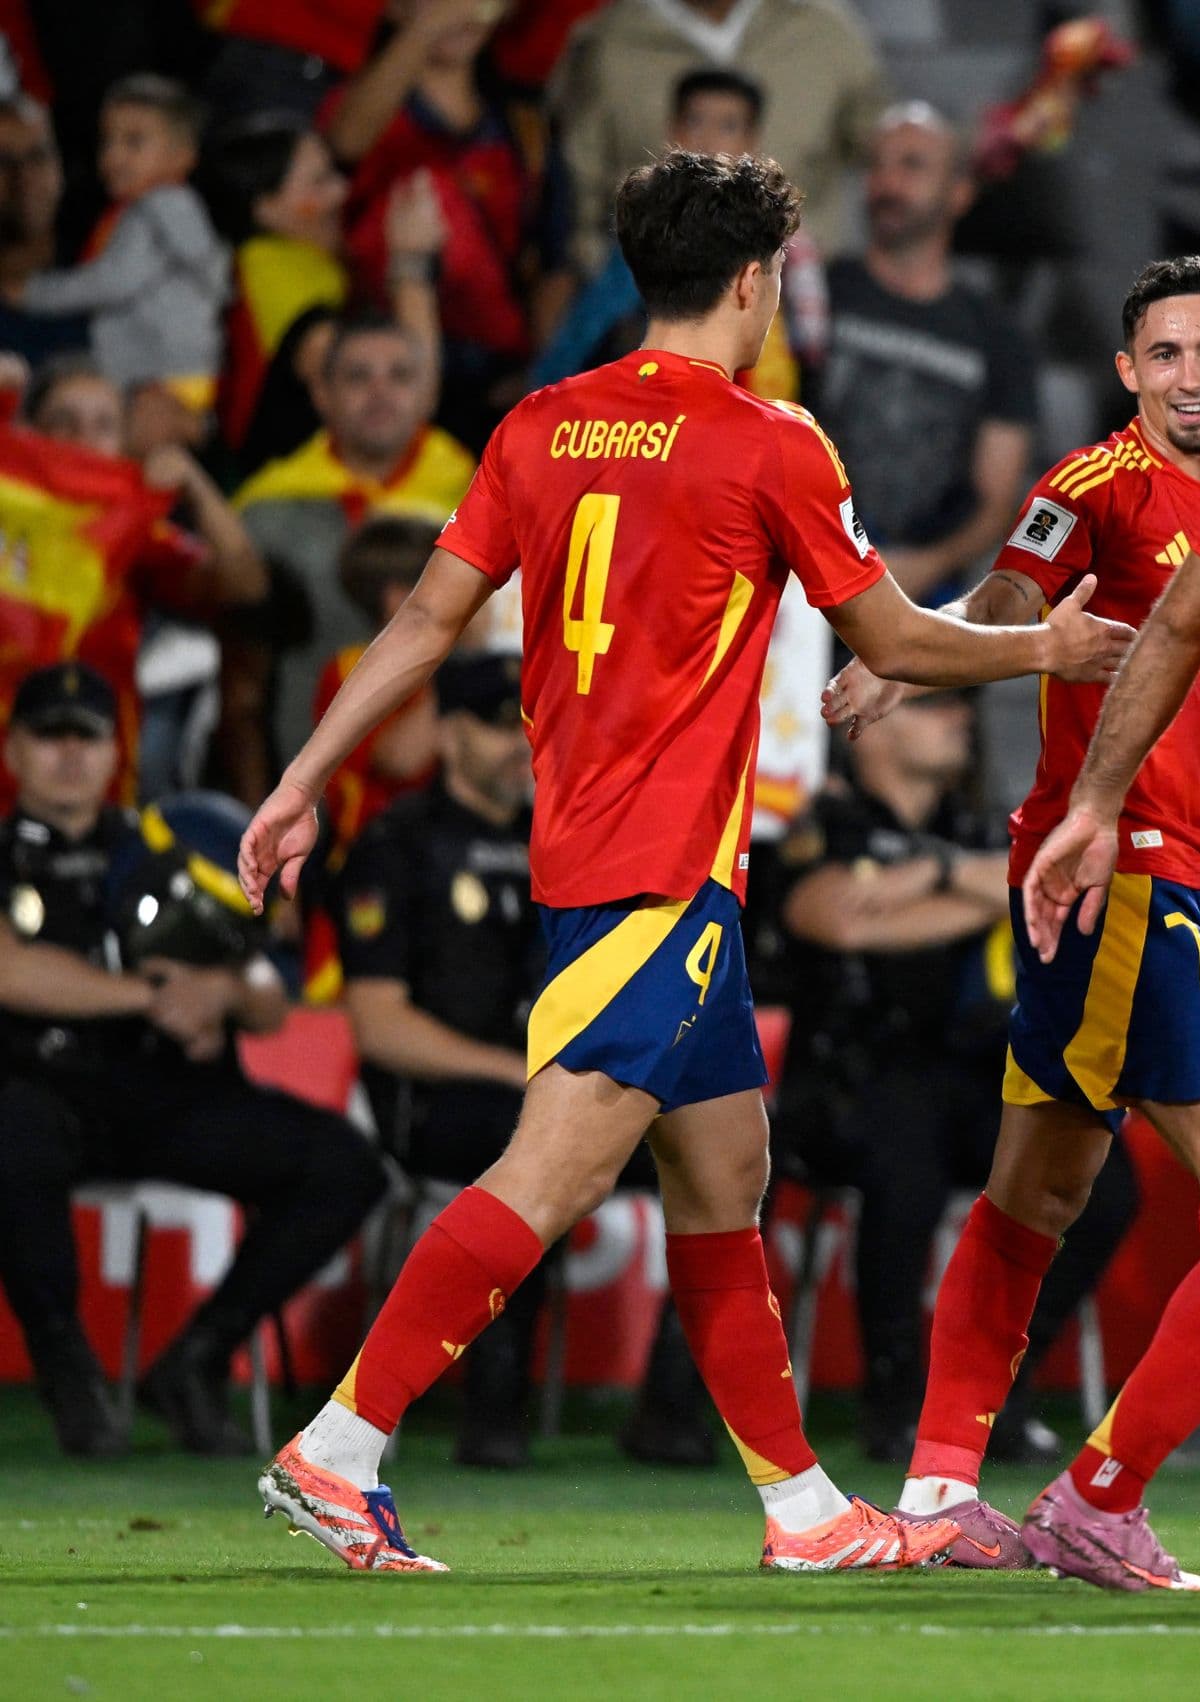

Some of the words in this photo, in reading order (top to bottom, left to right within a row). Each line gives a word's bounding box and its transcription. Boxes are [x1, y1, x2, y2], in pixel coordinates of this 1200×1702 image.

[550, 414, 687, 462] CUBARSÍ
[563, 492, 621, 695] 4
[685, 920, 724, 1007] 4
